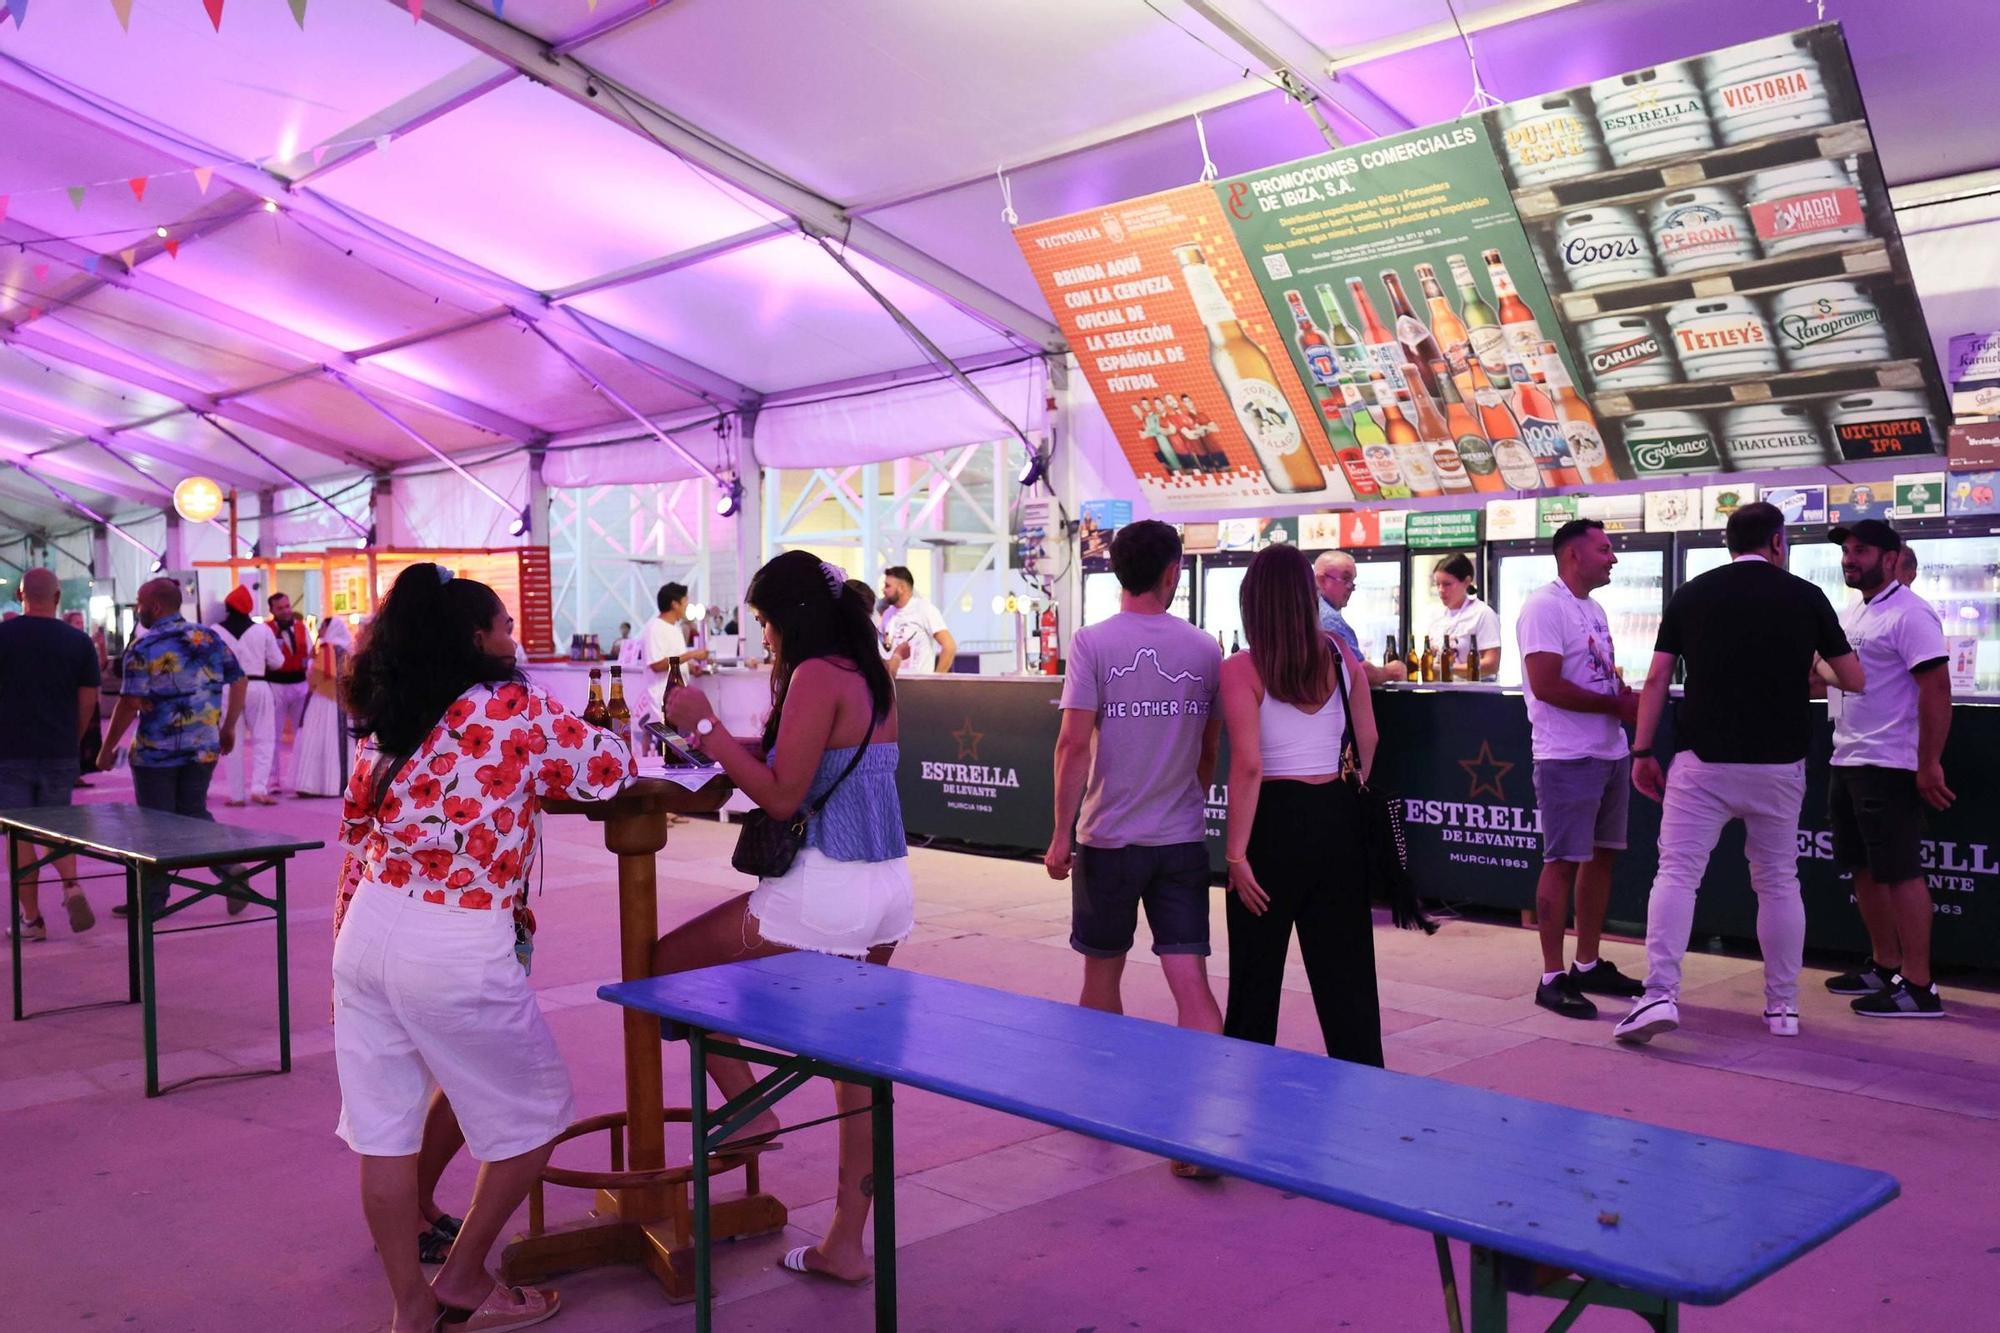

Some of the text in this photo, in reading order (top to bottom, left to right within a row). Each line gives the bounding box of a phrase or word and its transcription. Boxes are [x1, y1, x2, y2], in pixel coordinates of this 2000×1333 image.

[1723, 73, 1808, 108] VICTORIA
[1603, 101, 1700, 131] ESTRELLA
[1640, 117, 1680, 131] LEVANTE
[1251, 127, 1478, 197] PROMOCIONES COMERCIALES
[1259, 180, 1356, 212] DE IBIZA, S.A.
[1787, 192, 1841, 222] MADRÍ
[1035, 227, 1101, 249] VICTORIA
[1661, 224, 1737, 250] PERONI
[1562, 237, 1640, 265] Coors
[1052, 252, 1142, 287] BRINDA AQUÍ
[1064, 275, 1175, 309] CON LA CERVEZA
[1075, 304, 1146, 330] OFICIAL DE
[1817, 298, 1832, 314] S
[1085, 321, 1175, 351] LA SELECCIÓN
[1677, 321, 1764, 352] TETLEY'S
[1779, 308, 1880, 350] Staropramen
[1095, 346, 1185, 372] ESPAÑOLA DE
[1592, 340, 1658, 371] CARLING
[1106, 374, 1159, 393] FÚTBOL
[1730, 433, 1818, 450] THATCHERS
[1841, 421, 1922, 440] VICTORIA
[1637, 438, 1709, 470] Trabanco
[1870, 438, 1902, 452] IPA
[1104, 700, 1209, 717] HE OTHER FA
[921, 761, 1020, 787] ESTRELLA
[943, 784, 997, 798] DE LEVANTE
[947, 801, 975, 811] MURCIA
[1404, 799, 1545, 833] ESTRELL
[1442, 829, 1537, 849] DE LEVANTE
[1450, 853, 1529, 869] MURCIA 1963
